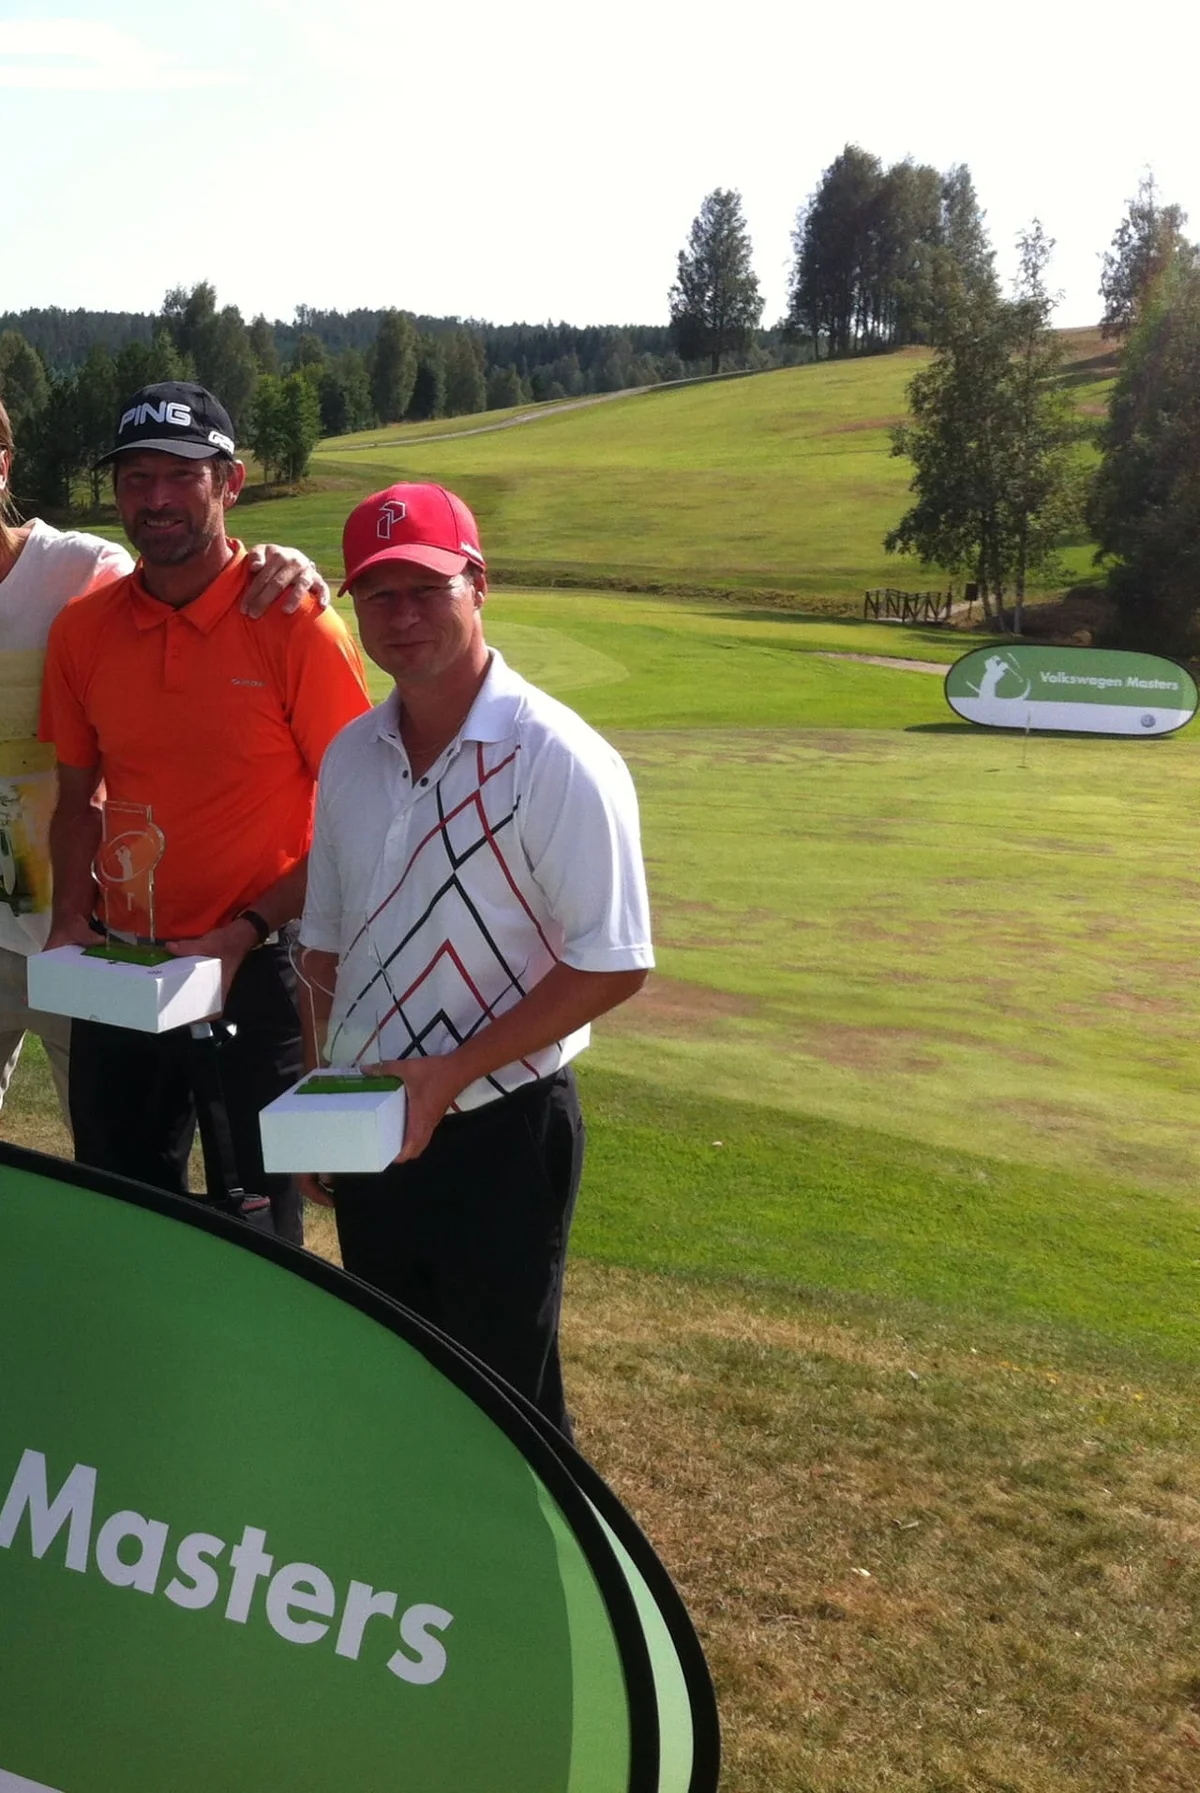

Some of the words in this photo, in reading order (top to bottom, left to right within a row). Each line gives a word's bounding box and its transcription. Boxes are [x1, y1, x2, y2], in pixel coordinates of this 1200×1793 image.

[119, 401, 191, 434] PING
[1040, 671, 1122, 689] Volkswagen
[1125, 676, 1179, 690] Masters
